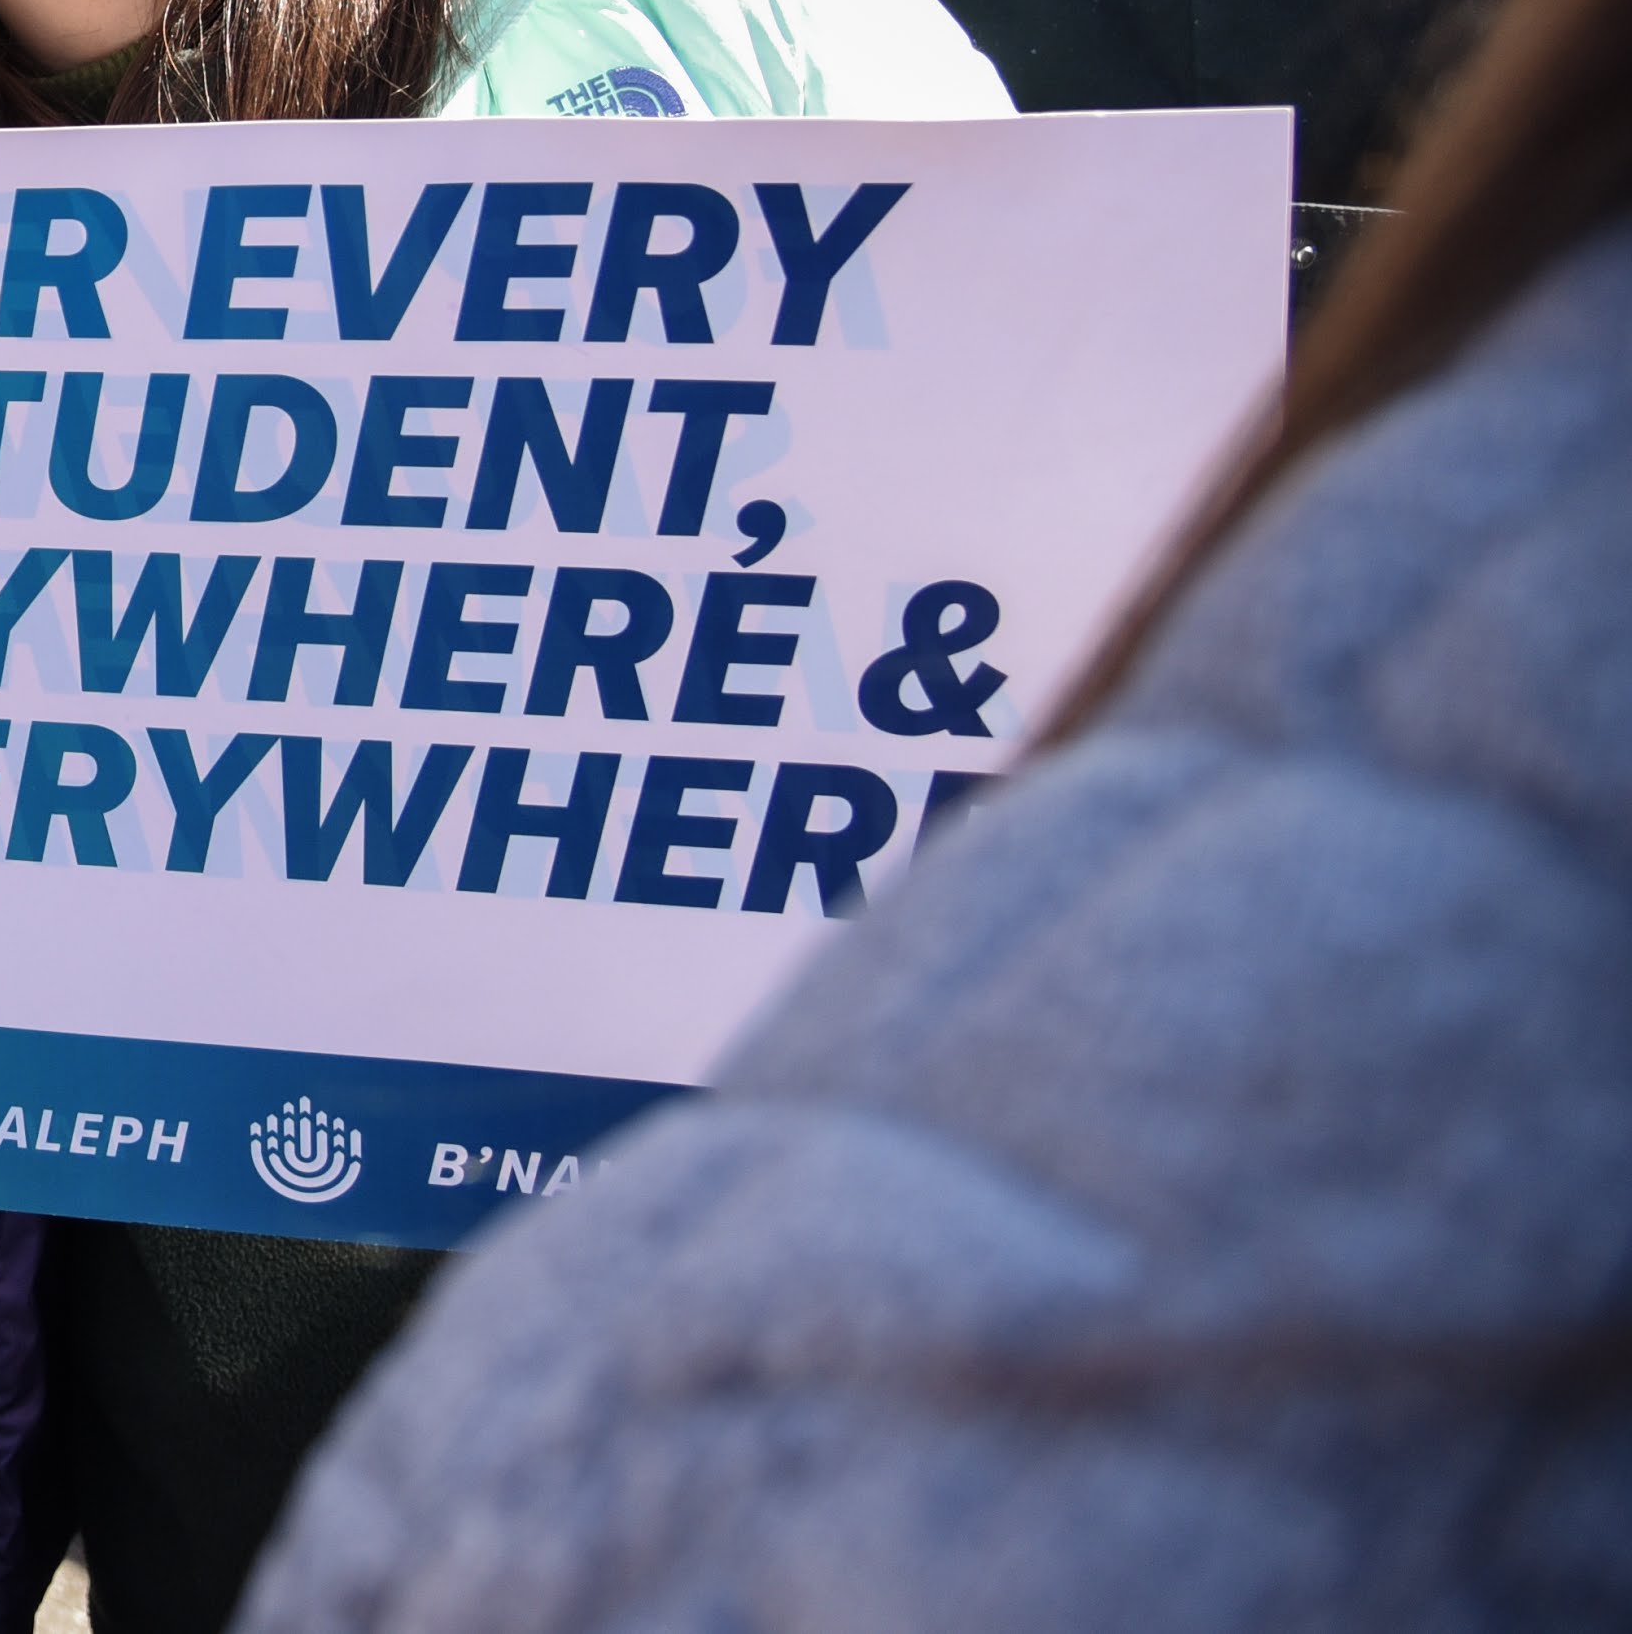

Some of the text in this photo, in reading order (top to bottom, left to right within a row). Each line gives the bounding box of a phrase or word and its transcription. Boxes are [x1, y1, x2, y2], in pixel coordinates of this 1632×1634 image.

[546, 74, 611, 113] THE
[183, 184, 914, 346] EVERY
[858, 580, 1008, 737] &
